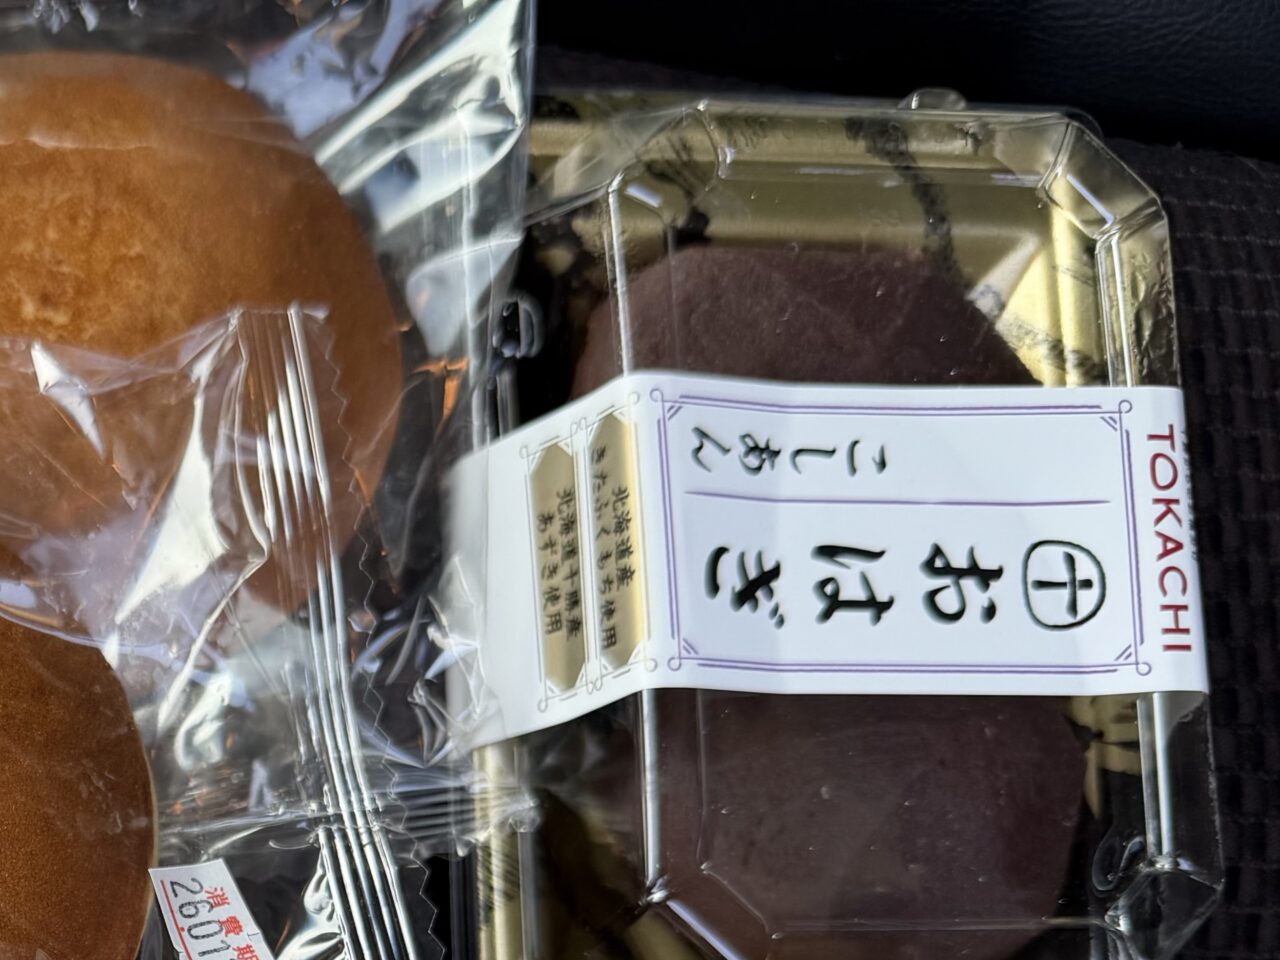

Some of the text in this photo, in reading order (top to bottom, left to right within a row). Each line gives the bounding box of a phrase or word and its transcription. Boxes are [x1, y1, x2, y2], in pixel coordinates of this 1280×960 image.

[689, 425, 888, 478] こしあん
[536, 512, 563, 636] あずき使用
[556, 488, 583, 642] 北海道十勝産
[591, 444, 617, 651] きたふくもち使用
[611, 485, 636, 592] 北海道産
[703, 541, 1006, 631] おはぎ
[1146, 423, 1193, 653] TOKACHI
